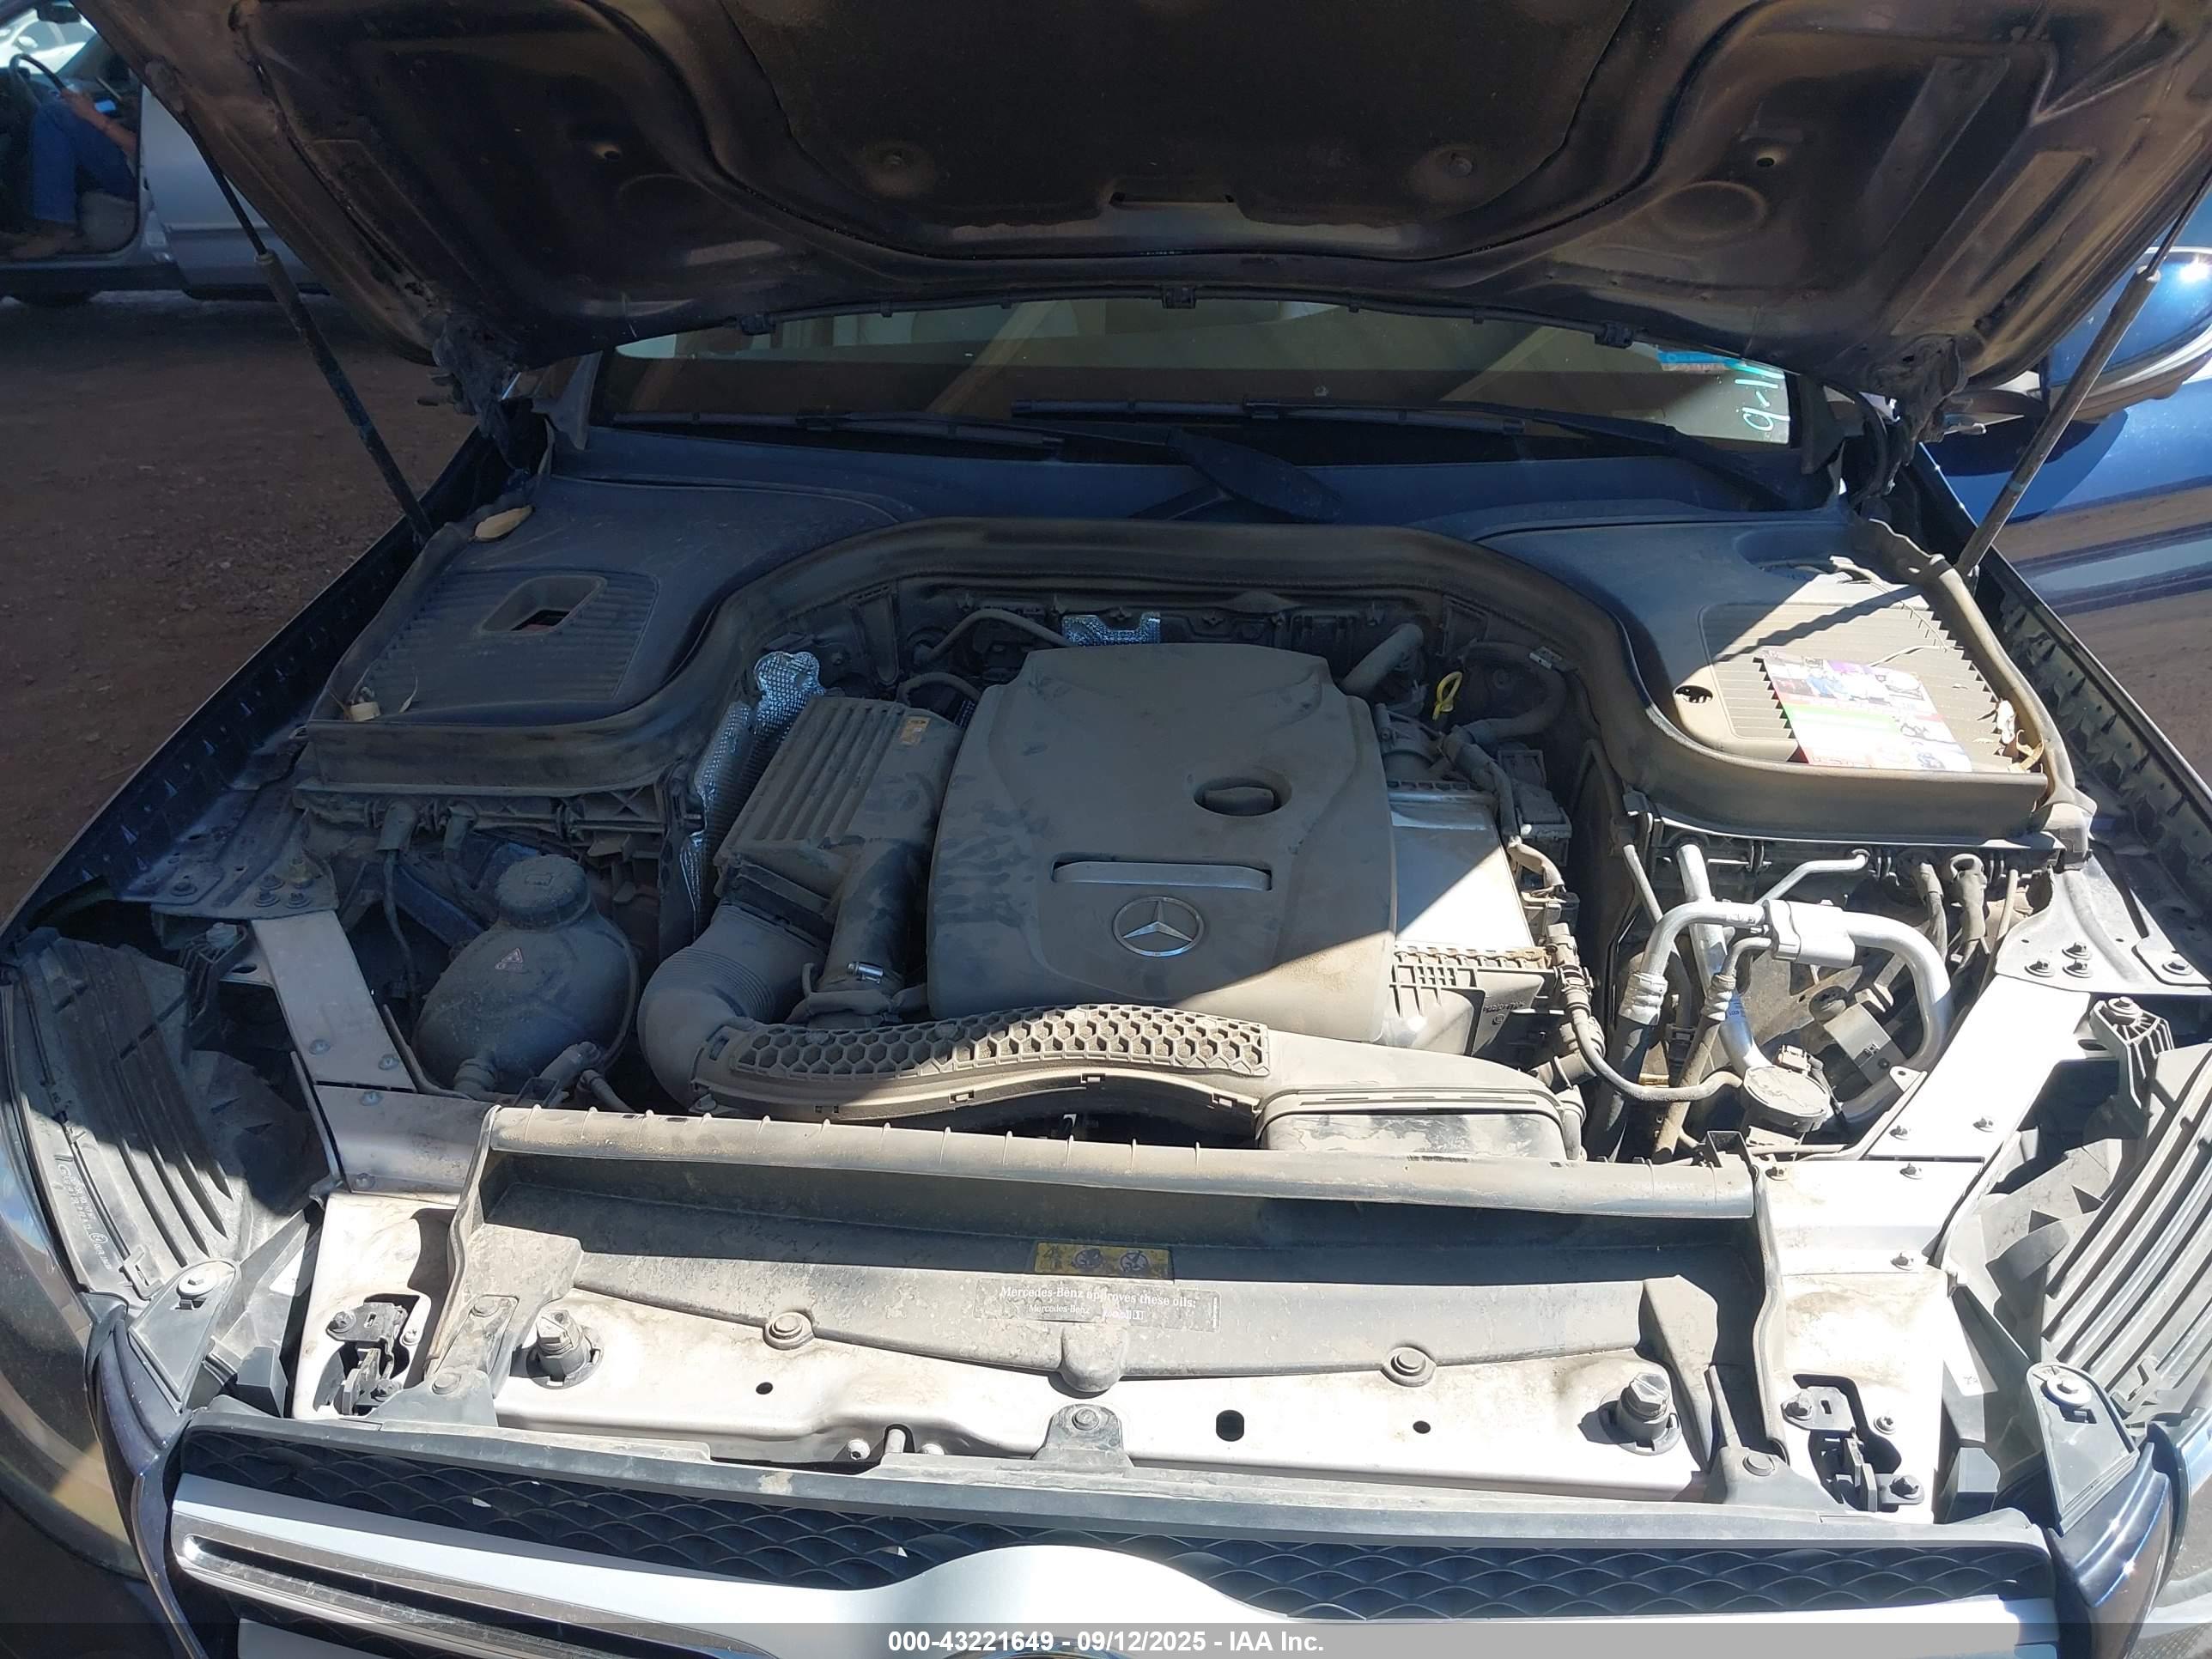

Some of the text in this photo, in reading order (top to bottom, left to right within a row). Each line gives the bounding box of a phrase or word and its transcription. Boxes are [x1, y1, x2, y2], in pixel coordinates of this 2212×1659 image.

[1000, 1285, 1084, 1299] Mercedes-Benz
[1139, 1293, 1170, 1306] these
[1172, 1296, 1197, 1309] oils:
[1028, 1304, 1090, 1315] Mercedes-Benz
